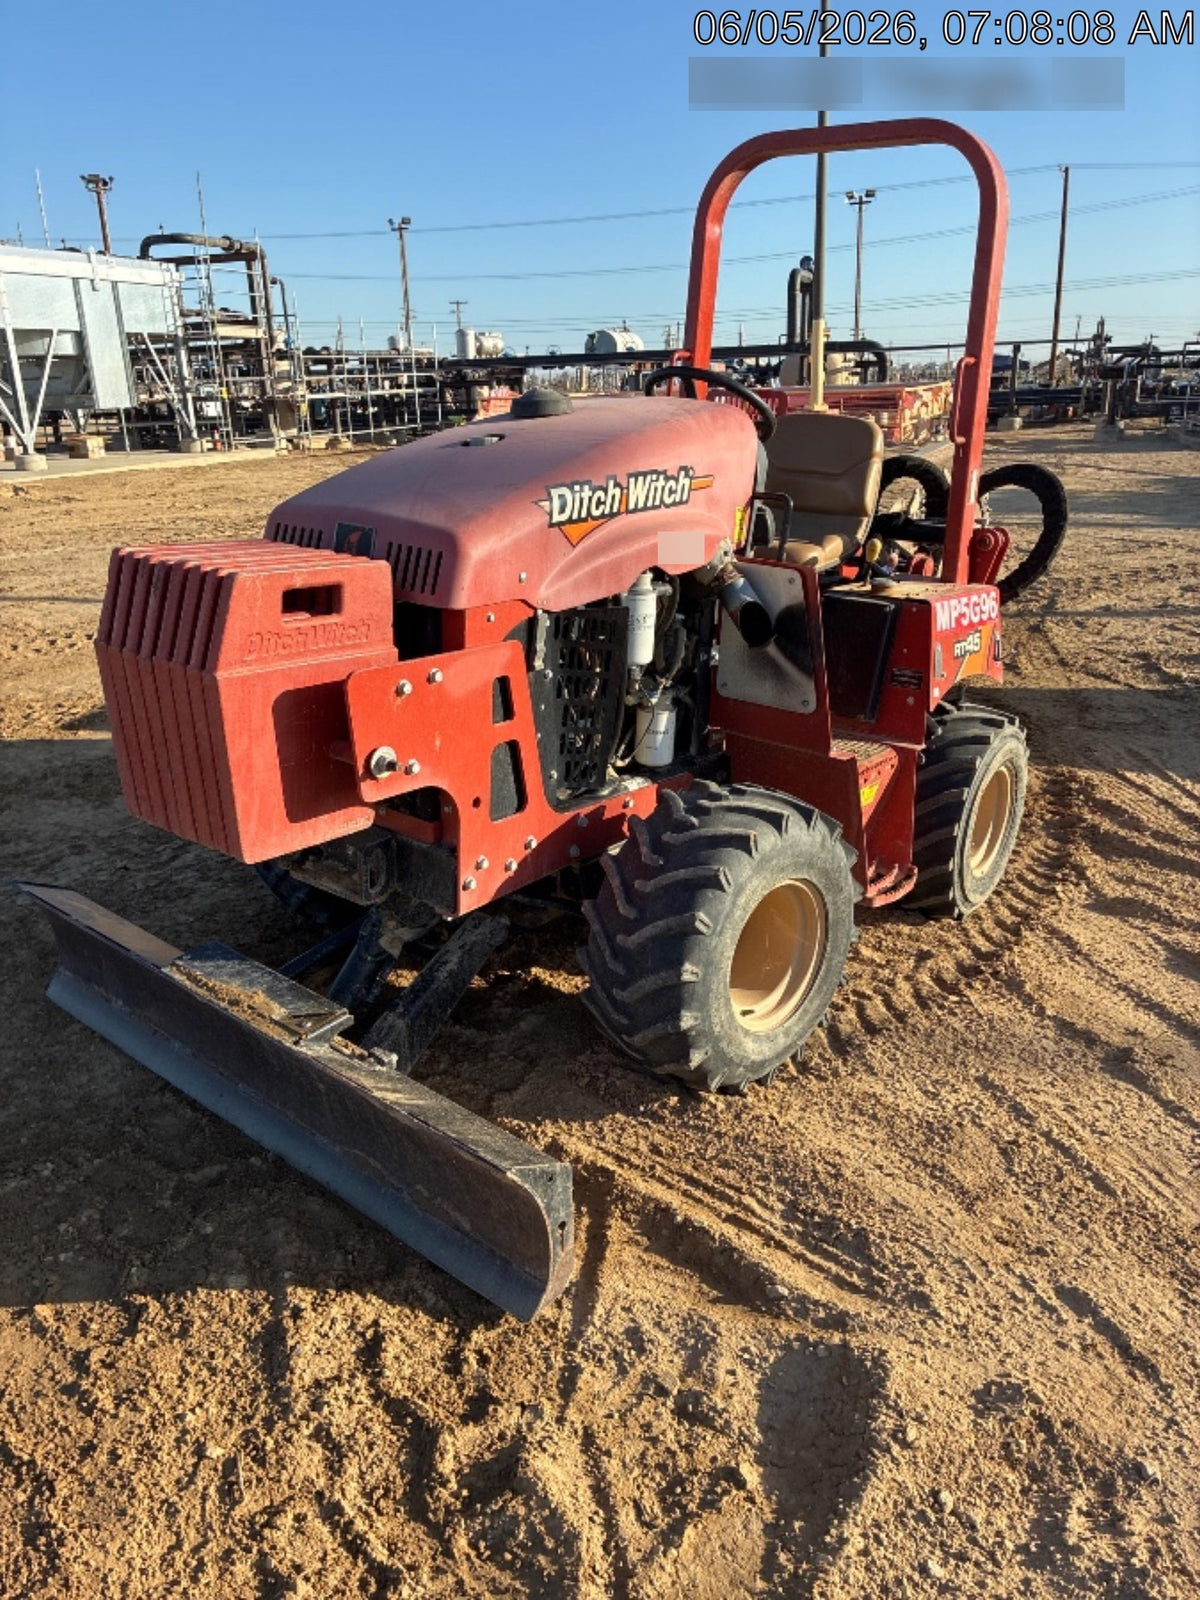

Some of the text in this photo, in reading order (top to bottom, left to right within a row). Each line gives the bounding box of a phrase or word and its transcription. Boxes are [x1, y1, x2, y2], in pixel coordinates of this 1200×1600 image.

[549, 467, 692, 525] Ditch Witch
[935, 591, 998, 632] MP5G96
